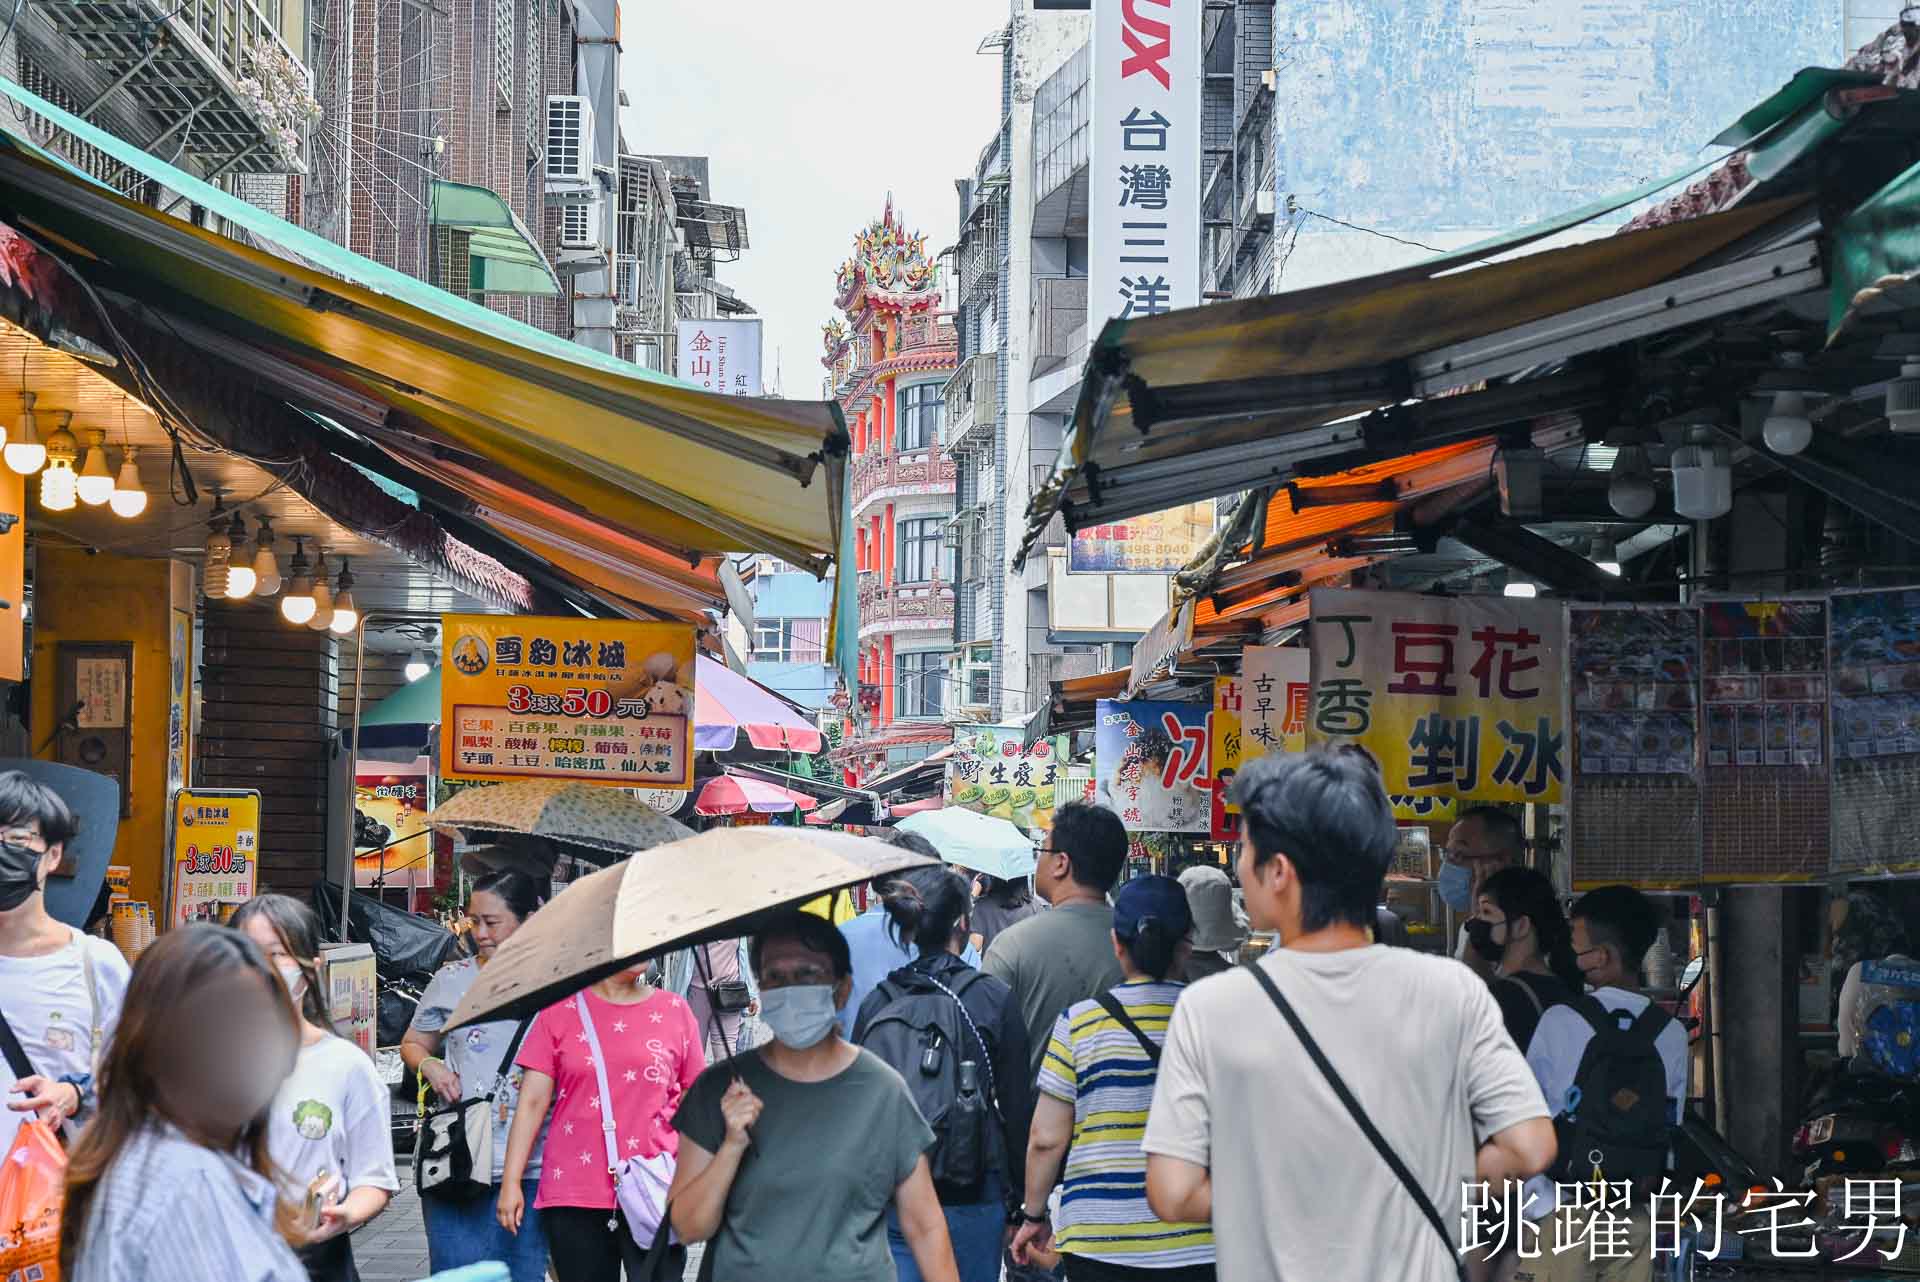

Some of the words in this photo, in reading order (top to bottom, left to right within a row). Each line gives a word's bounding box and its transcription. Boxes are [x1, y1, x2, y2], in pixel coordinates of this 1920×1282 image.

[1119, 106, 1172, 320] 台灣三洋
[495, 636, 626, 669] 雪豹冰城
[1387, 622, 1542, 700] 豆花
[1316, 614, 1373, 737] 丁香
[507, 684, 650, 720] 3球50元
[1249, 672, 1279, 746] 古早味
[462, 719, 494, 732] 芒果
[508, 720, 560, 734] 百香果
[574, 723, 625, 738] 青蘋果
[640, 727, 673, 740] 草莓
[462, 735, 493, 749] 鳳梨
[504, 737, 537, 750] 酸梅
[594, 741, 628, 755] 葡萄
[460, 751, 494, 765] 芋頭
[508, 754, 540, 768] 土豆
[554, 757, 606, 771] 哈密瓜
[620, 759, 672, 773] 仙人掌
[1002, 740, 1050, 758] 阿山
[1407, 713, 1565, 796] 剉冰
[1122, 719, 1144, 822] 金山老字號
[186, 845, 247, 873] 3球50元
